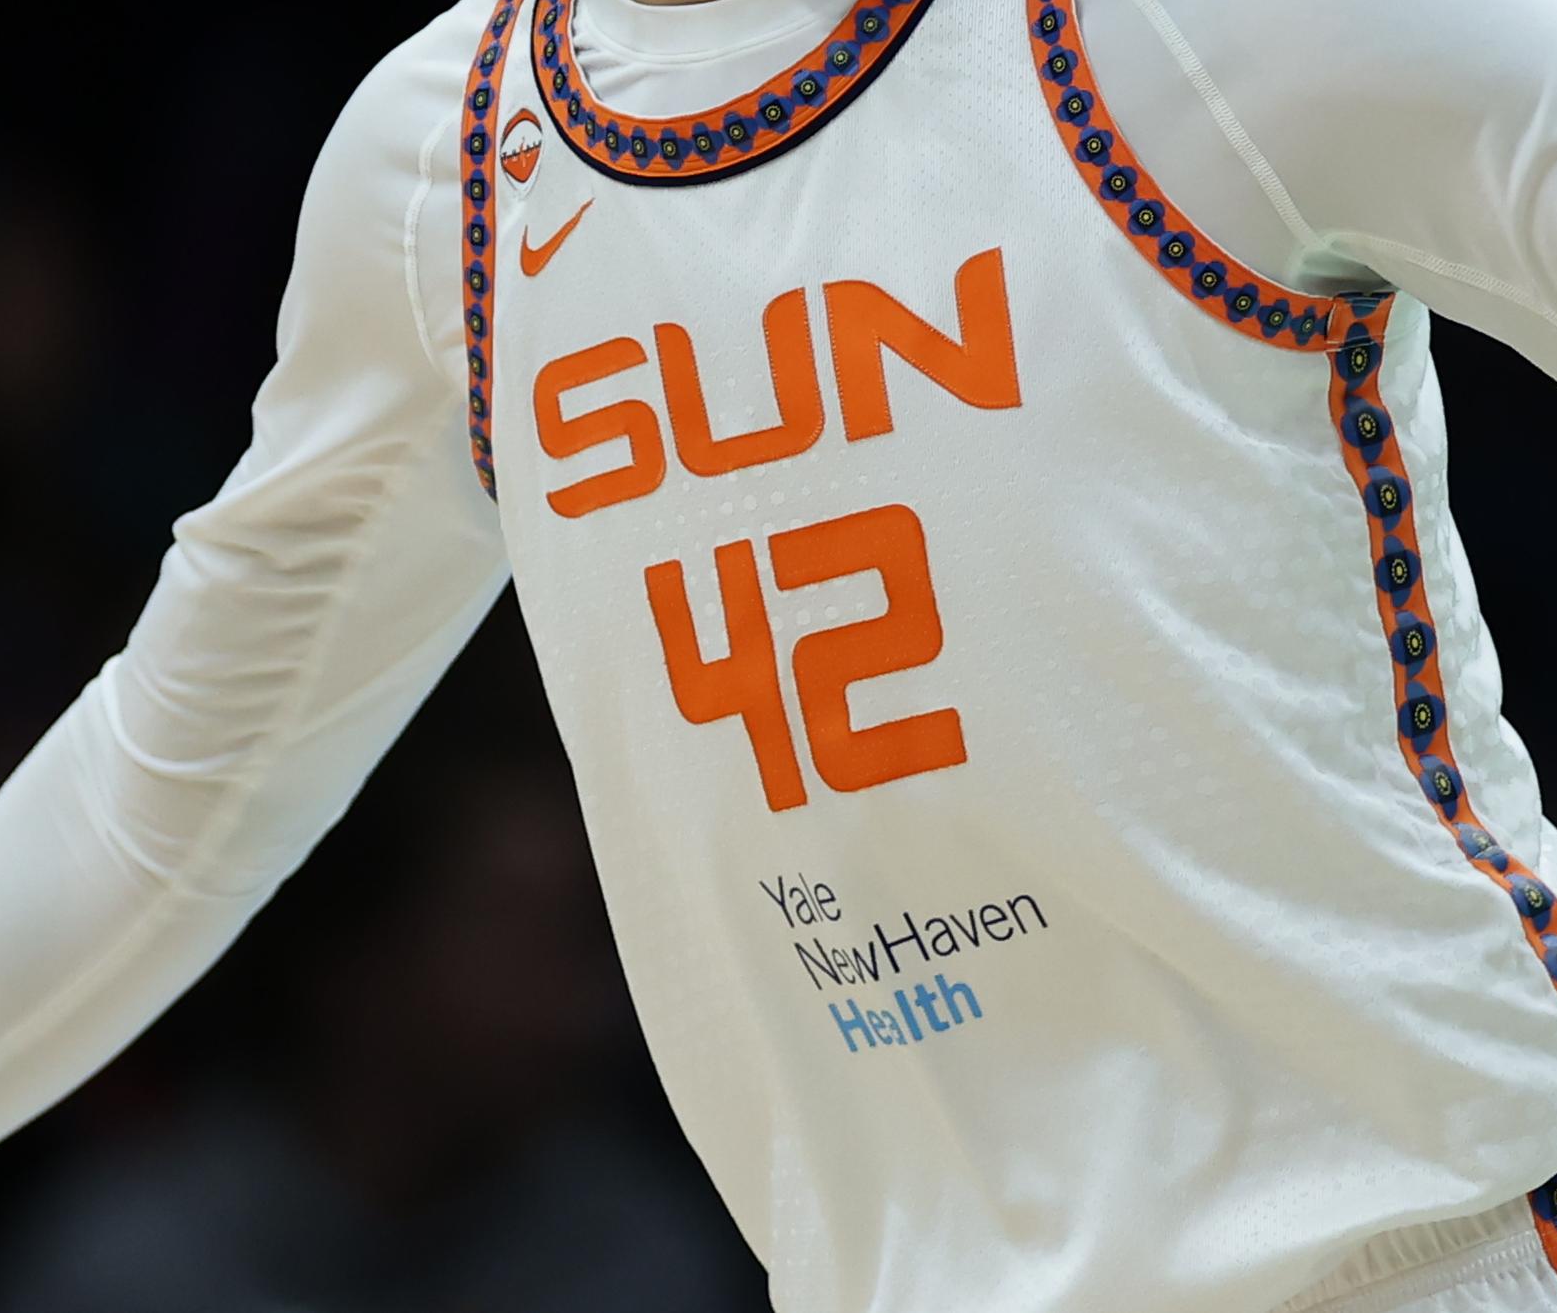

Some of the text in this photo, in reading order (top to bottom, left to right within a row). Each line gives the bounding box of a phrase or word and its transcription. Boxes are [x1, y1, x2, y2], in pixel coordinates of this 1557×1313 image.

[533, 247, 1023, 519] SUN
[643, 503, 969, 813] 42
[758, 872, 842, 929] Yale
[793, 893, 1048, 990] NewHaven
[828, 973, 983, 1053] Health
